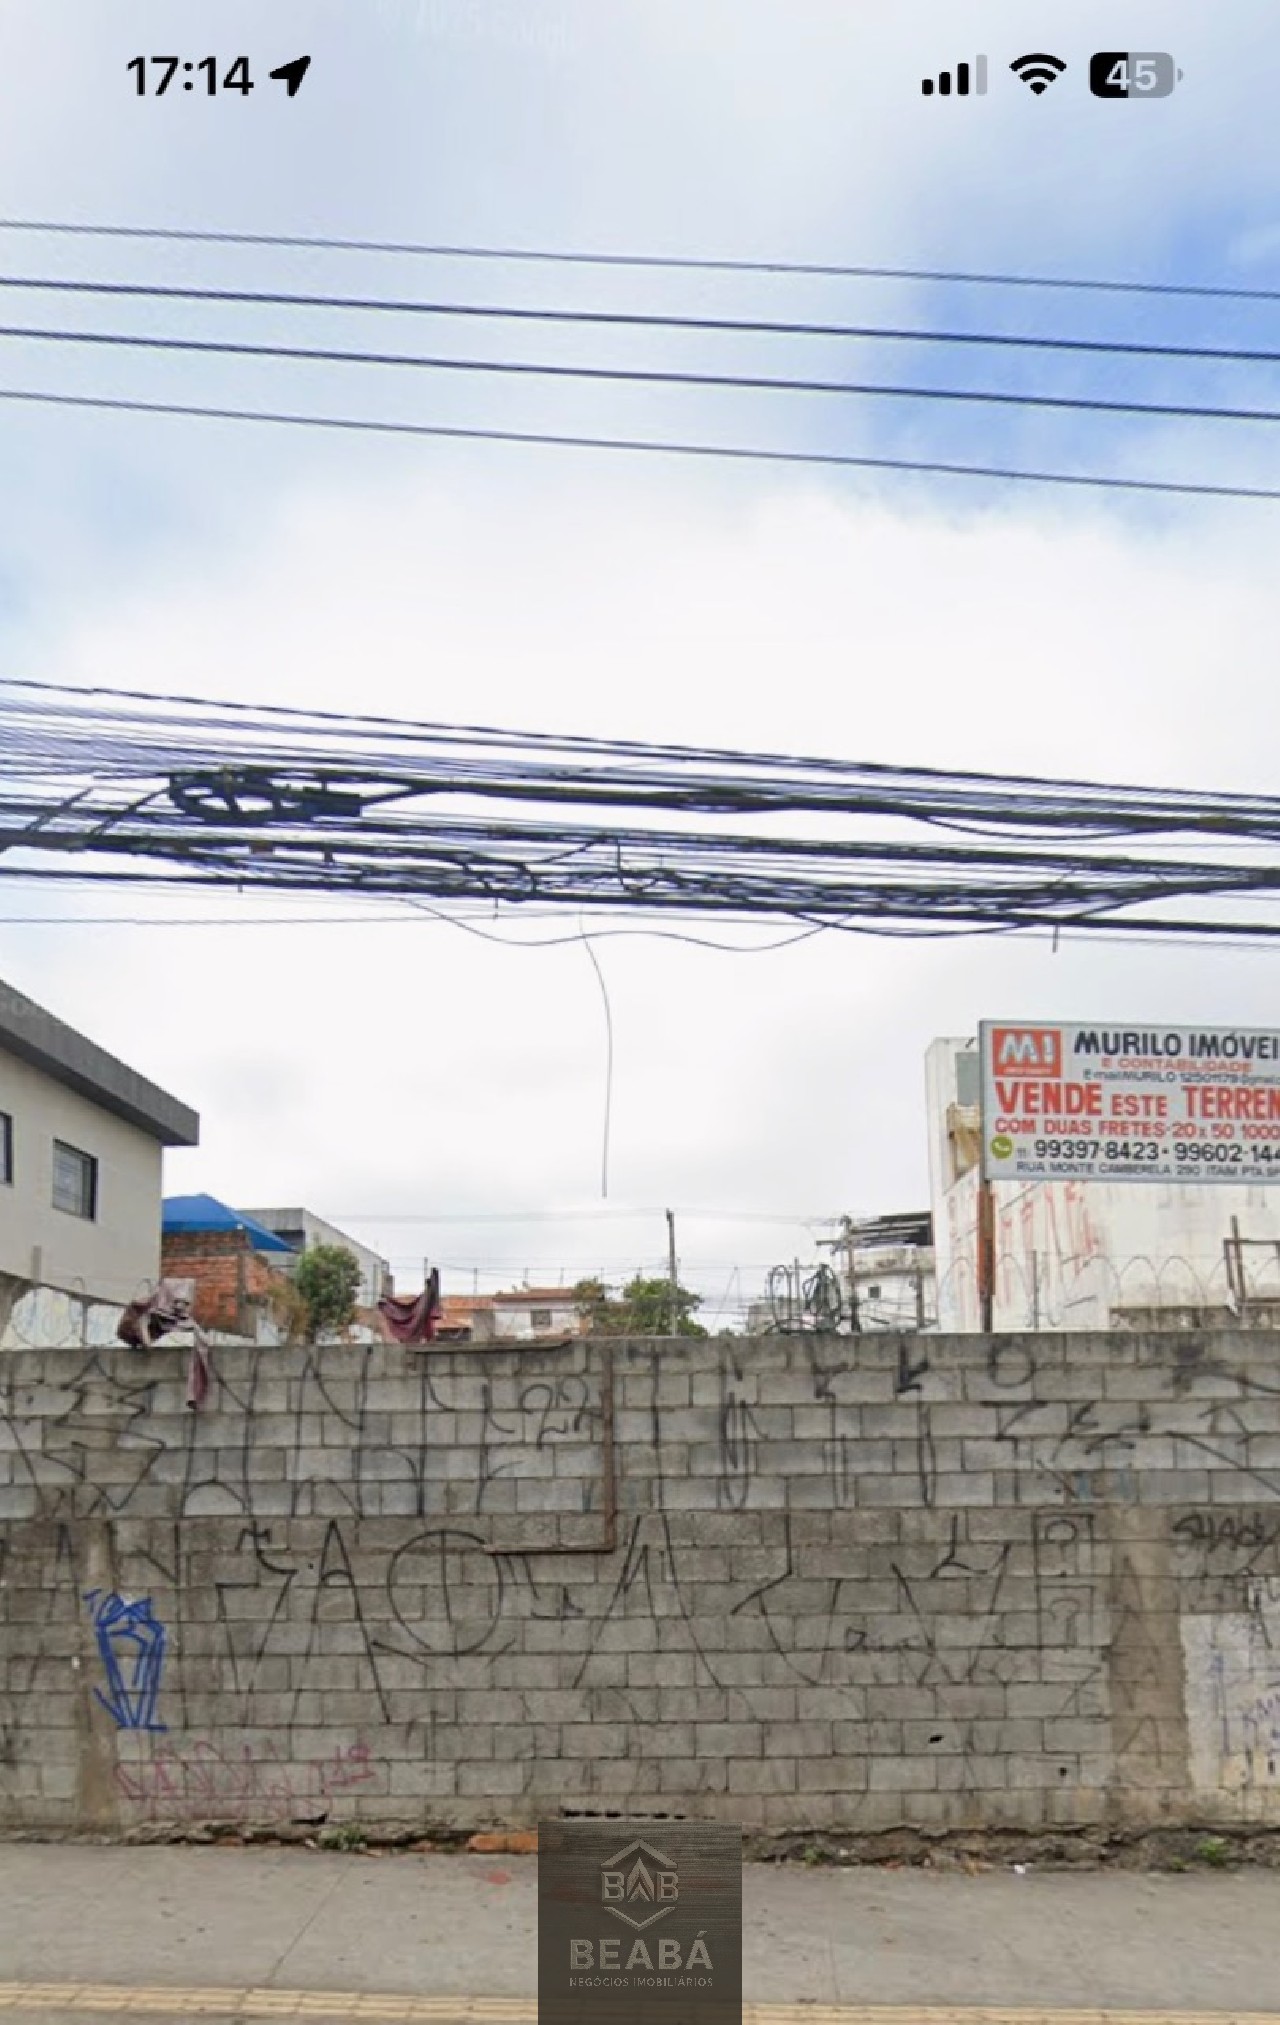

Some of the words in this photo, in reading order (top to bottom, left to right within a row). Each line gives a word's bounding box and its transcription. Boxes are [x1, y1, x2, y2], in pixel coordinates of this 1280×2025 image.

[1074, 1030, 1181, 1056] MURILO
[1102, 1058, 1111, 1068] E
[1118, 1058, 1252, 1072] CONTABILIDADE
[995, 1082, 1102, 1116] VENDE
[1112, 1094, 1167, 1117] ESTE
[995, 1118, 1036, 1134] COM
[1045, 1119, 1092, 1135] DUAS
[1211, 1123, 1235, 1139] 50
[1034, 1139, 1159, 1160] 99397-8423
[1017, 1161, 1045, 1172] RUA
[1051, 1162, 1094, 1173] MONTE
